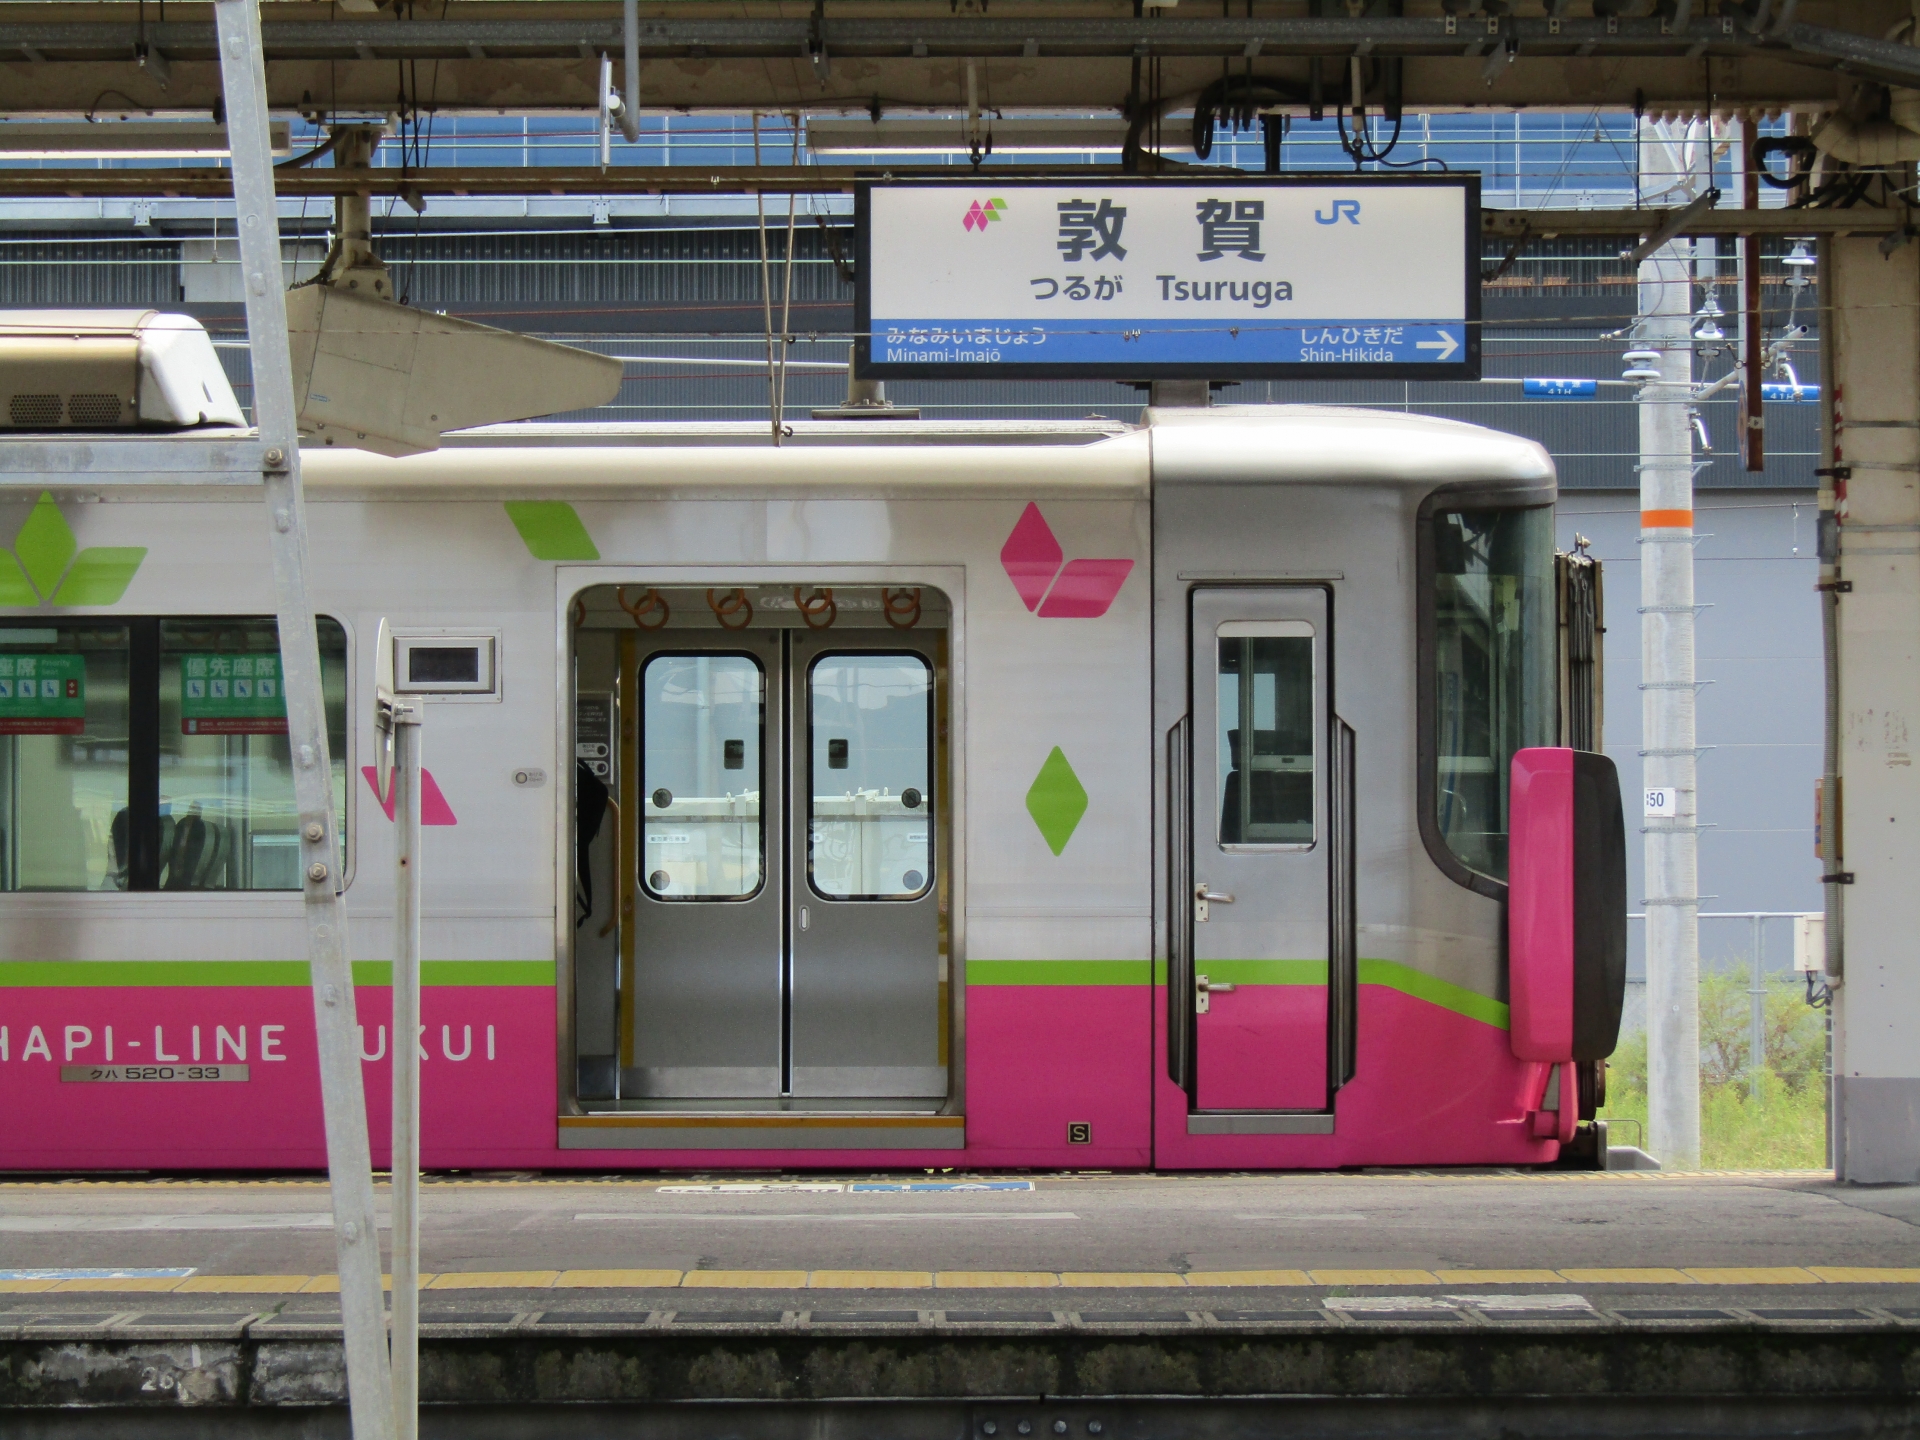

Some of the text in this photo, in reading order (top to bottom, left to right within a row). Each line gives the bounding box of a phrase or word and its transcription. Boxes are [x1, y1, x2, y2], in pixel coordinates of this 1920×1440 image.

[1314, 199, 1361, 225] JR
[1056, 198, 1266, 262] 敦賀
[1030, 274, 1124, 301] つるが
[1156, 275, 1294, 308] Tsuruga
[886, 327, 1047, 345] みなみいまじょう
[1300, 326, 1404, 345] しんひきだ
[886, 348, 1001, 363] Minami-Imajō
[1300, 347, 1394, 362] Shin-Hikida
[1646, 792, 1665, 807] 50
[90, 1066, 220, 1080] クハ 520-33
[1073, 1126, 1086, 1141] S
